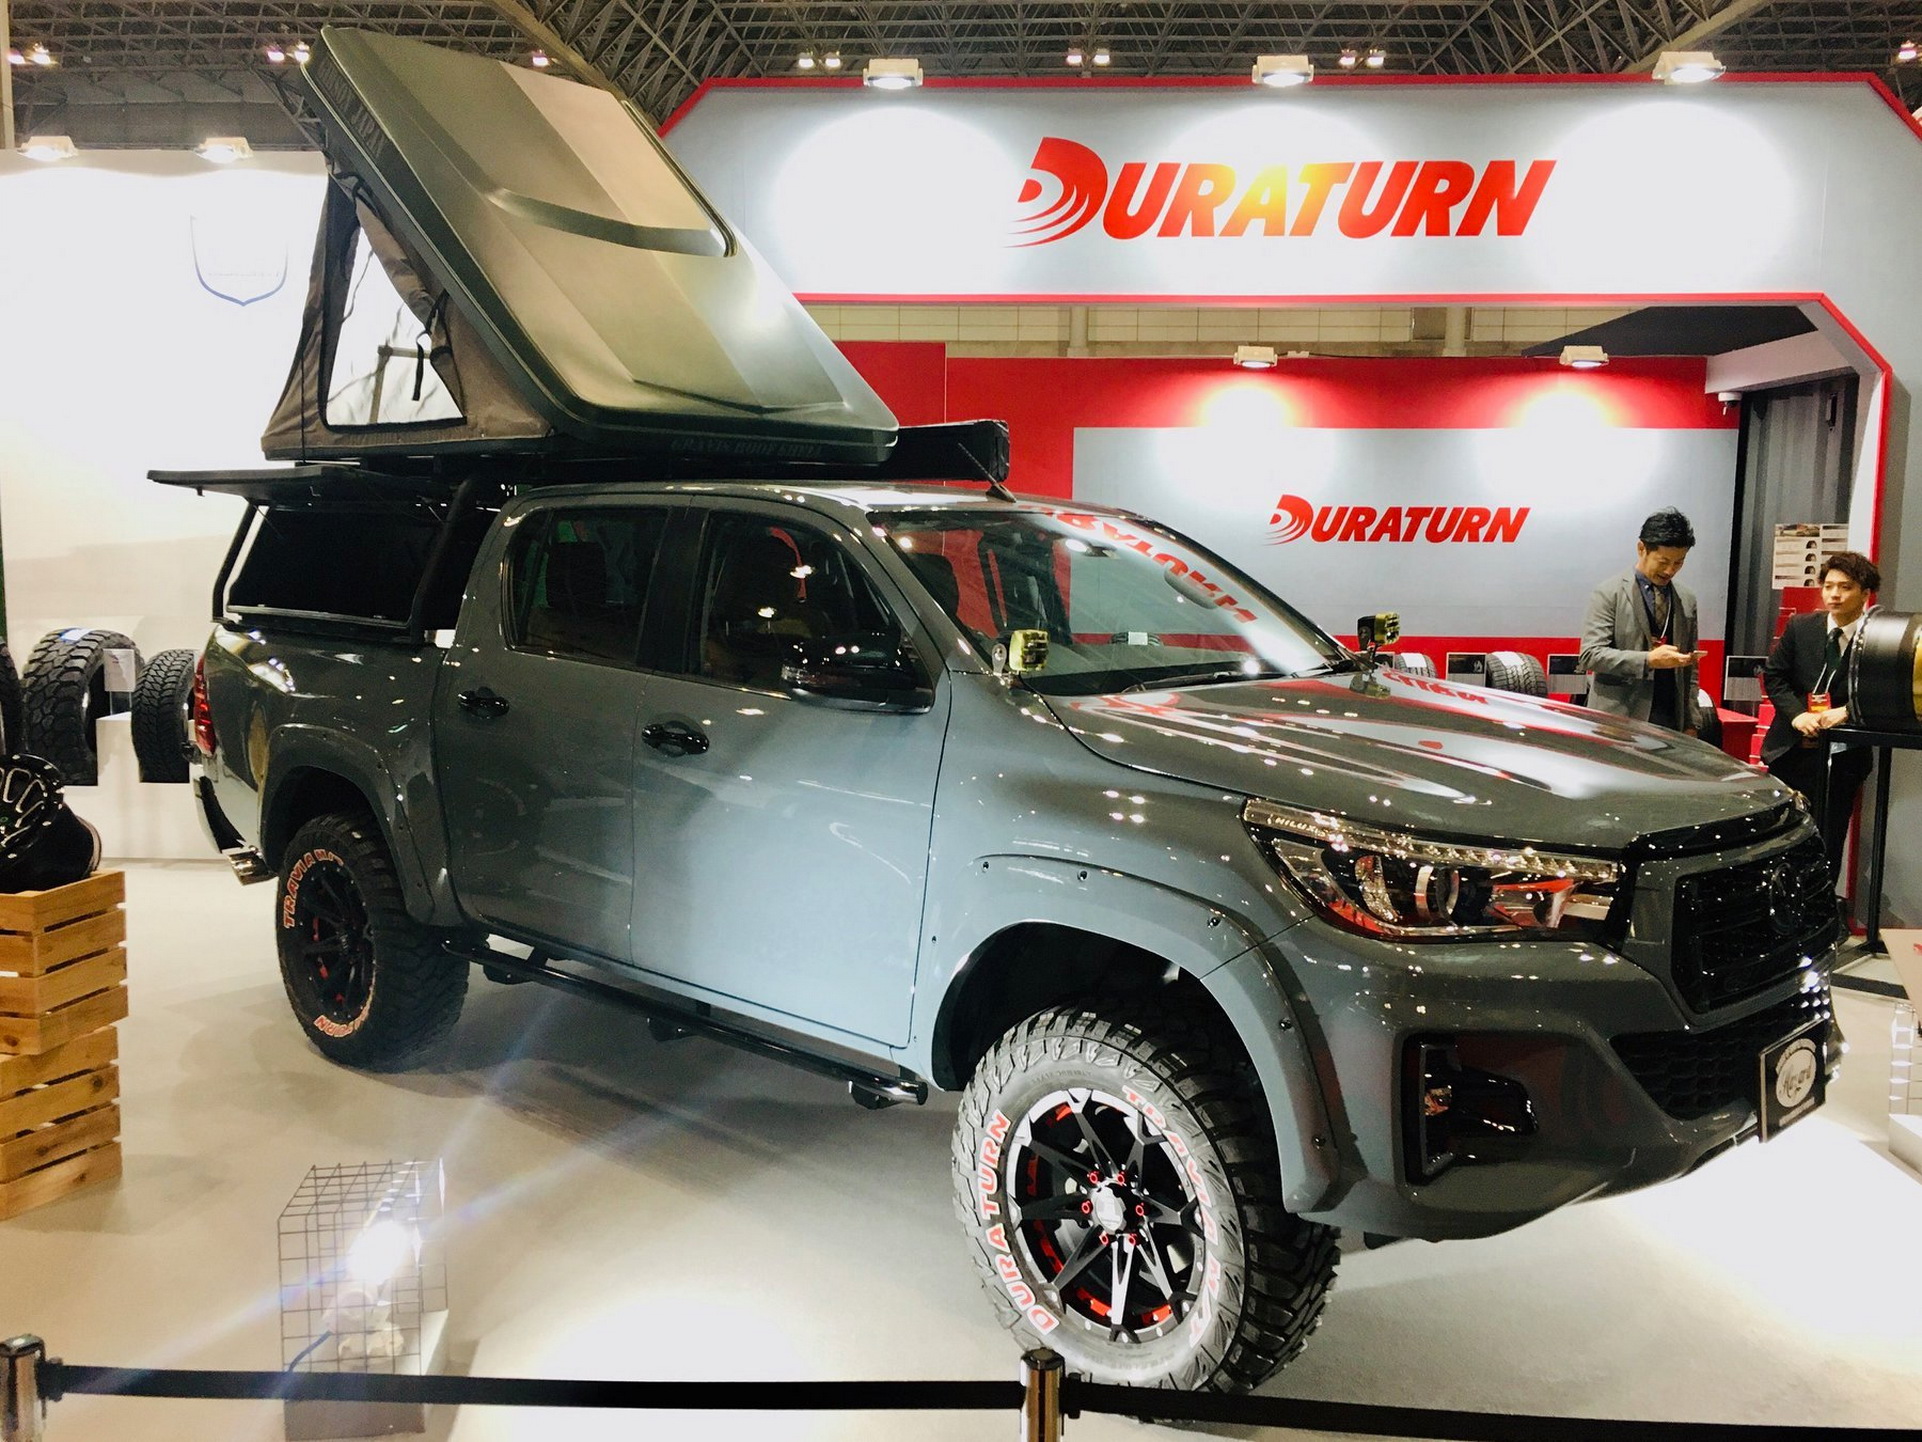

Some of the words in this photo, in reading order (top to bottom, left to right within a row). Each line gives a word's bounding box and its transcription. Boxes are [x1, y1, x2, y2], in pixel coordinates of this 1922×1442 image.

[1002, 136, 1557, 247] DURATURN
[1263, 494, 1531, 545] DURATURN
[977, 1108, 1060, 1336] DURATURN
